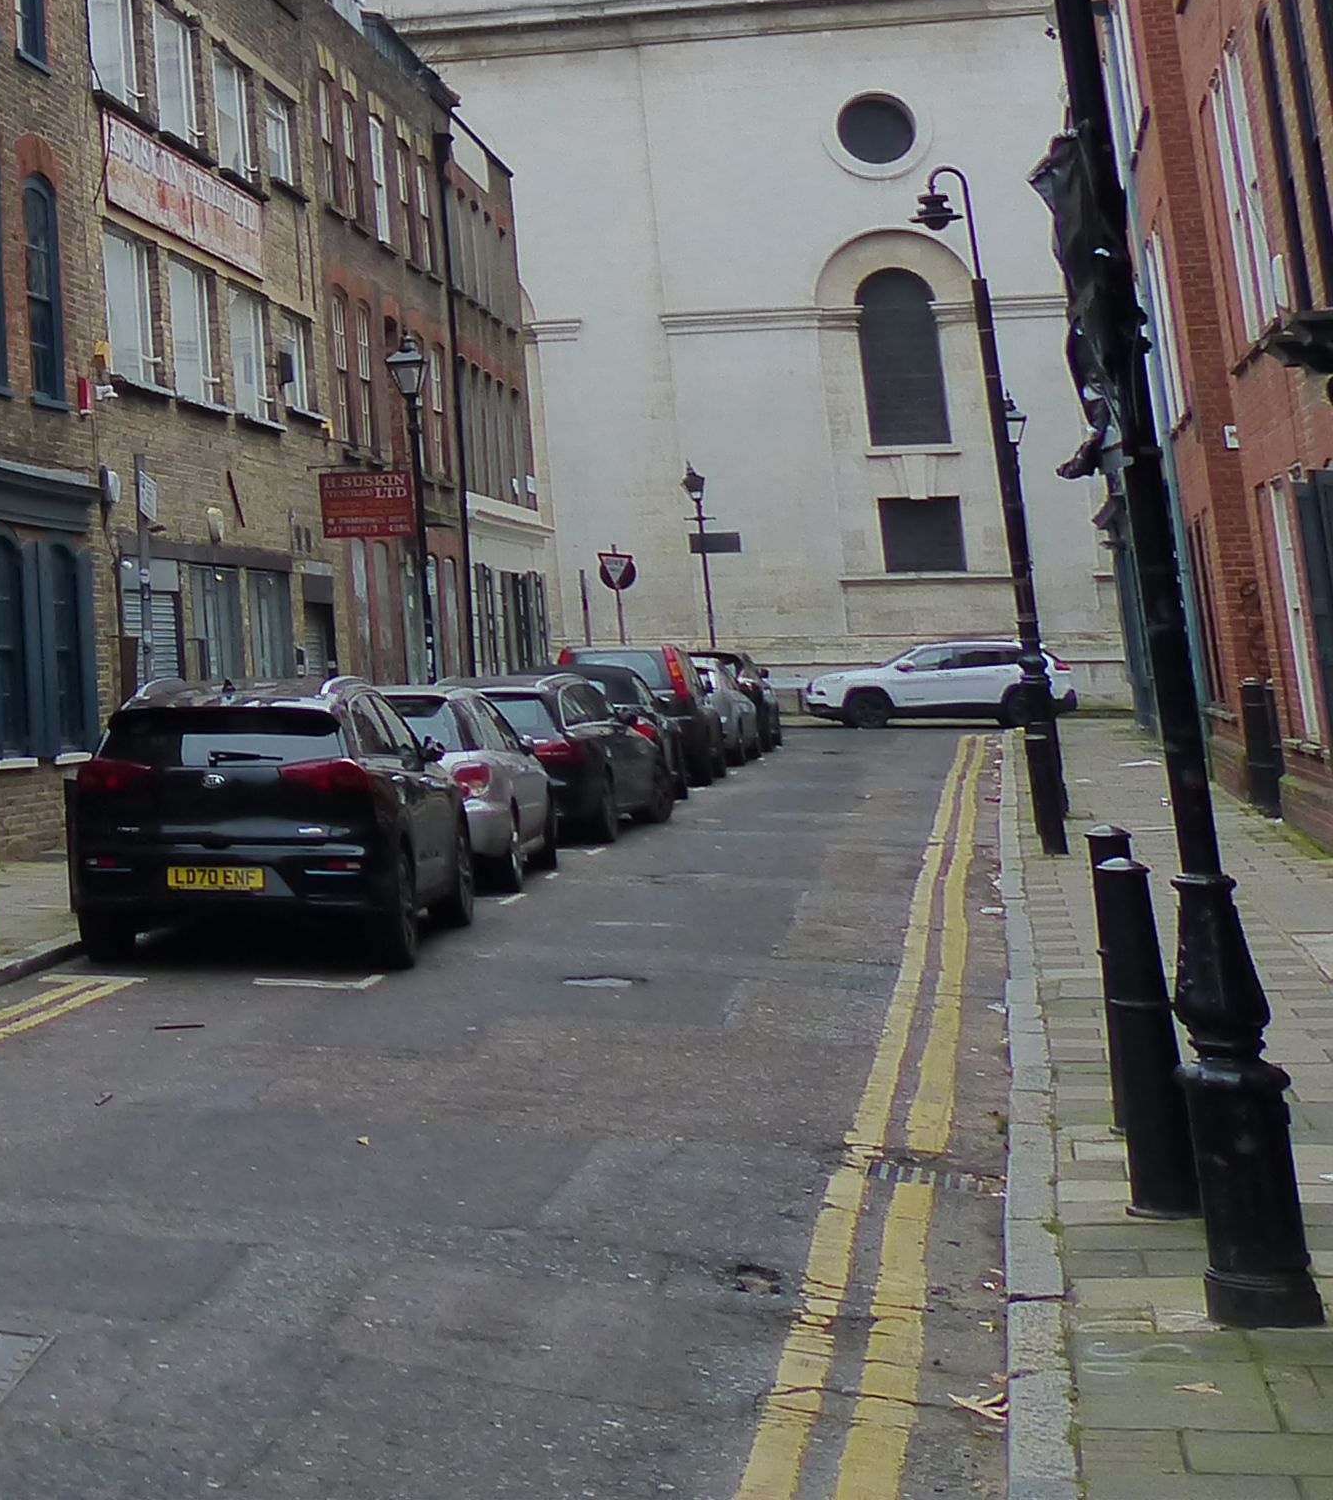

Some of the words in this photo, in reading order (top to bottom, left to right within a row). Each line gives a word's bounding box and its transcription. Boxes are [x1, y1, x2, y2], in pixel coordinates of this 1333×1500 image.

[375, 487, 407, 498] LTD
[174, 868, 218, 886] LD70
[222, 868, 257, 886] ENF
